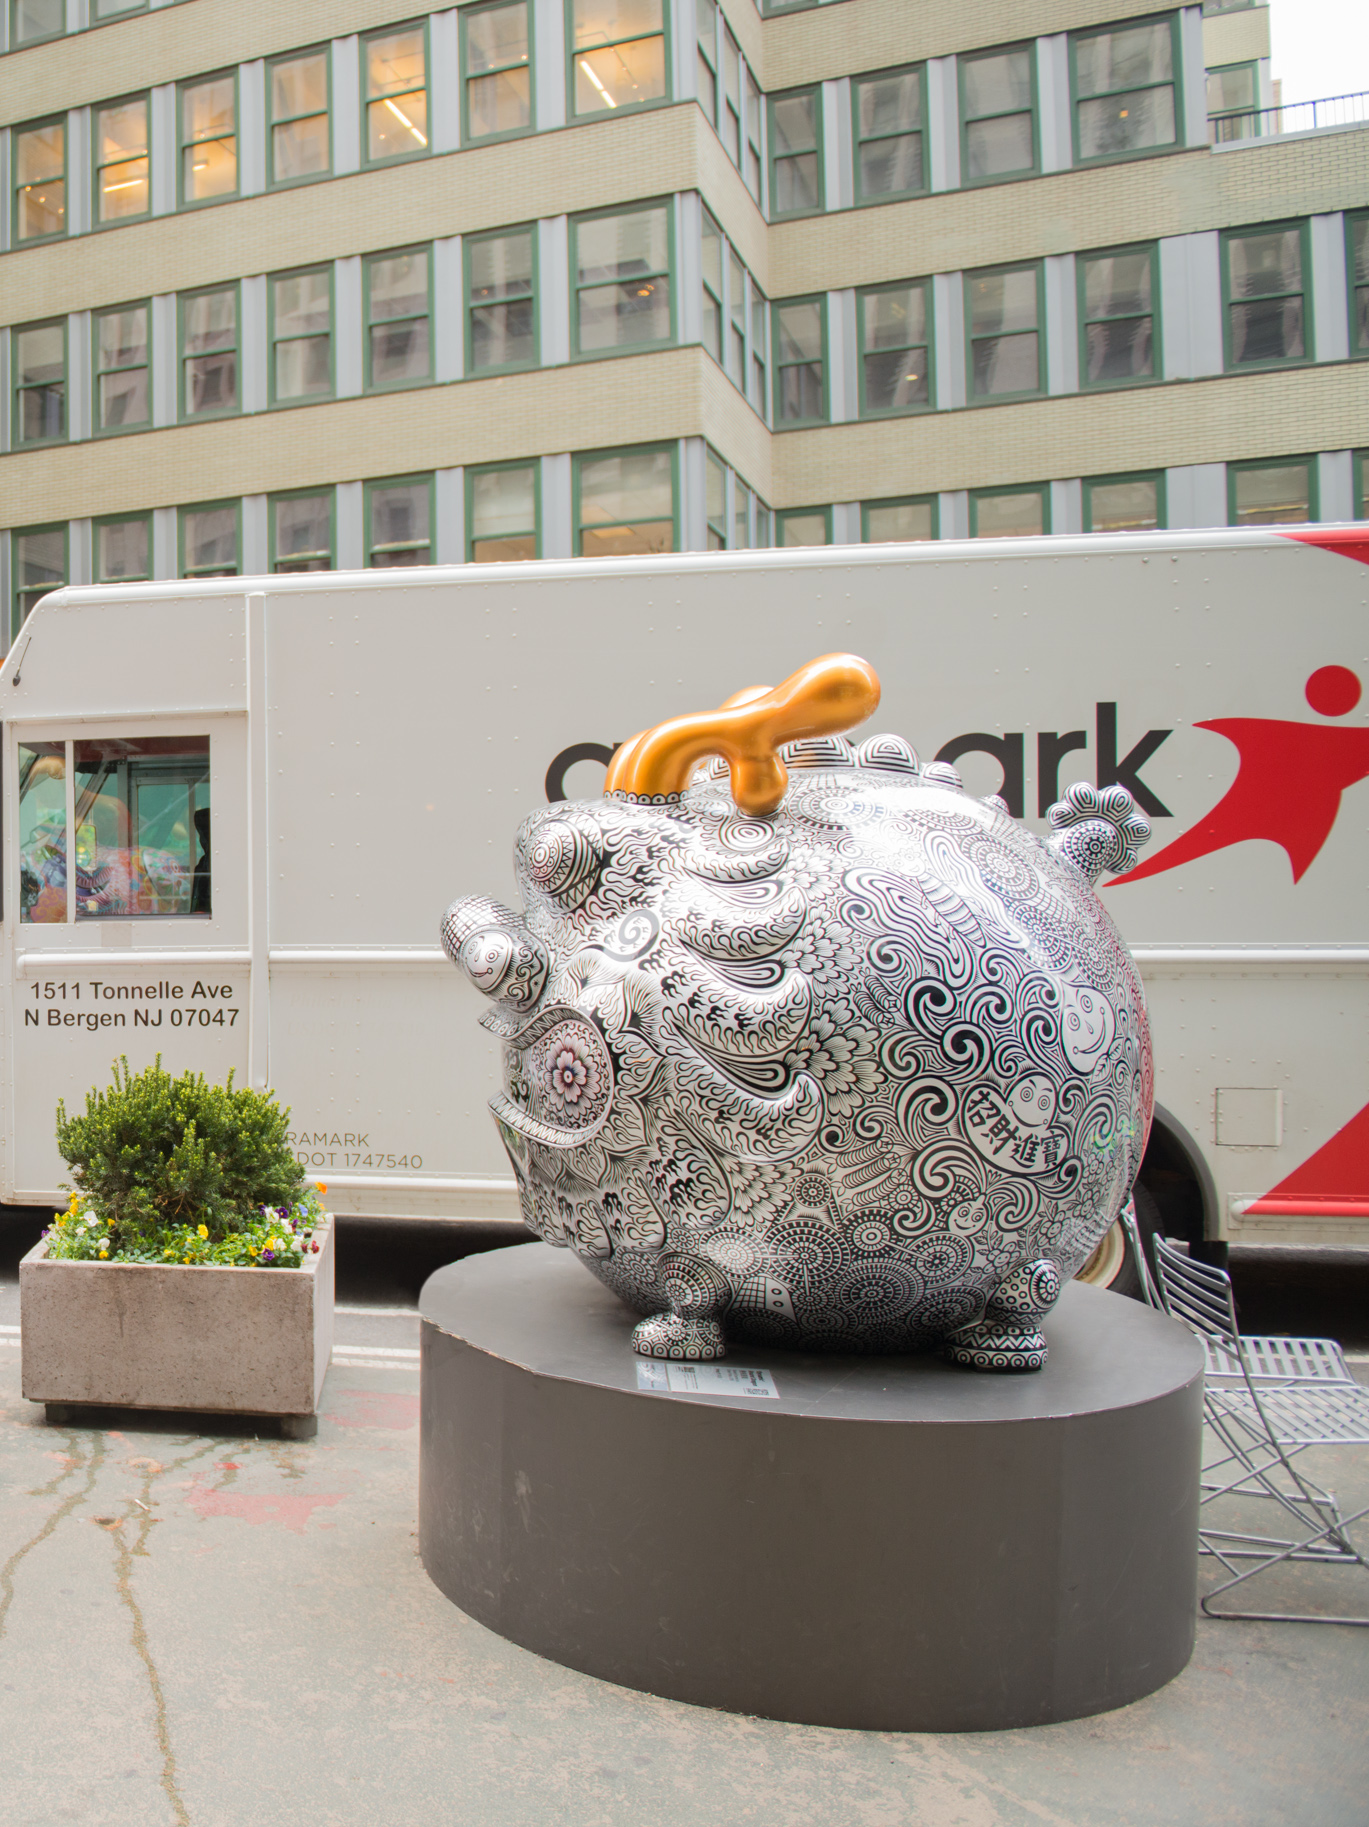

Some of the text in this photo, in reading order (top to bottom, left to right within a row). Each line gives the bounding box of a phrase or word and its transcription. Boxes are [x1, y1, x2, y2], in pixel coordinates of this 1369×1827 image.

[30, 981, 233, 1000] 1511 Tonnelle Ave
[24, 1008, 240, 1031] N Bergen NJ 07047
[344, 1153, 423, 1169] 1747540
